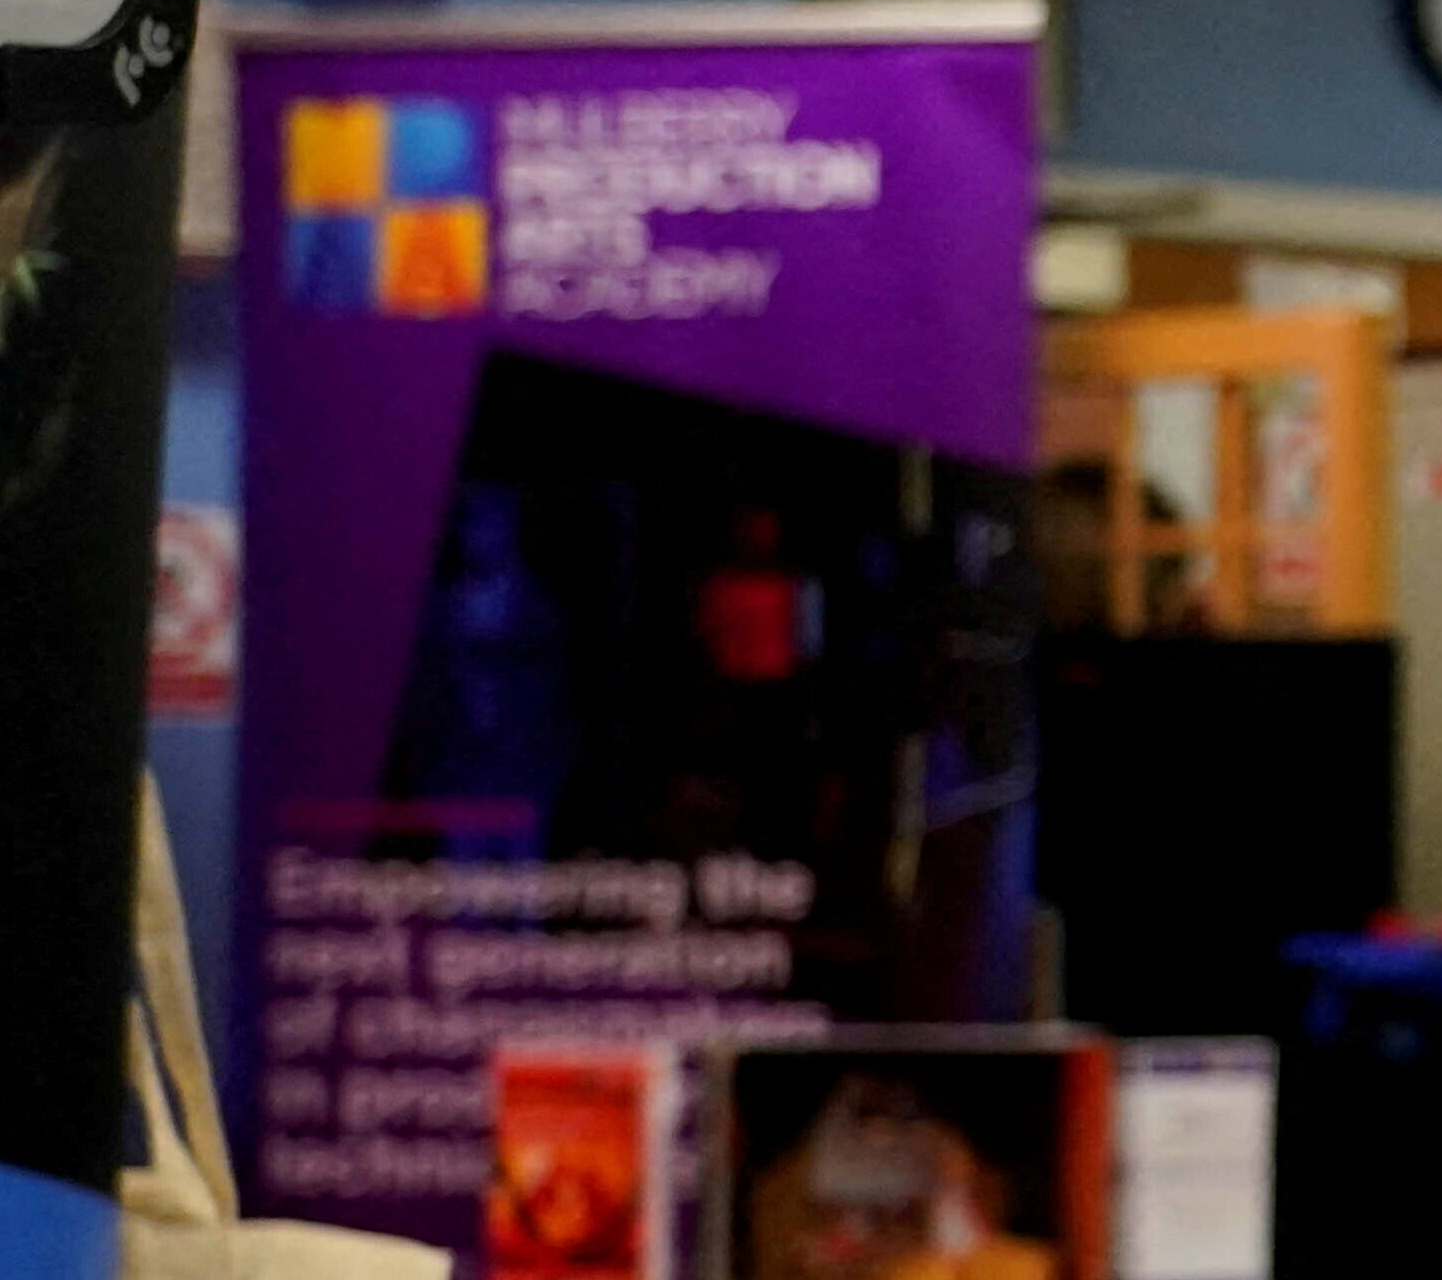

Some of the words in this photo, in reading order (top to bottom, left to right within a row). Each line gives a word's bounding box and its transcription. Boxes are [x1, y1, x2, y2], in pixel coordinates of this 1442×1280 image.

[270, 852, 686, 930] Empowering
[698, 853, 814, 920] the
[428, 928, 792, 1002] generation
